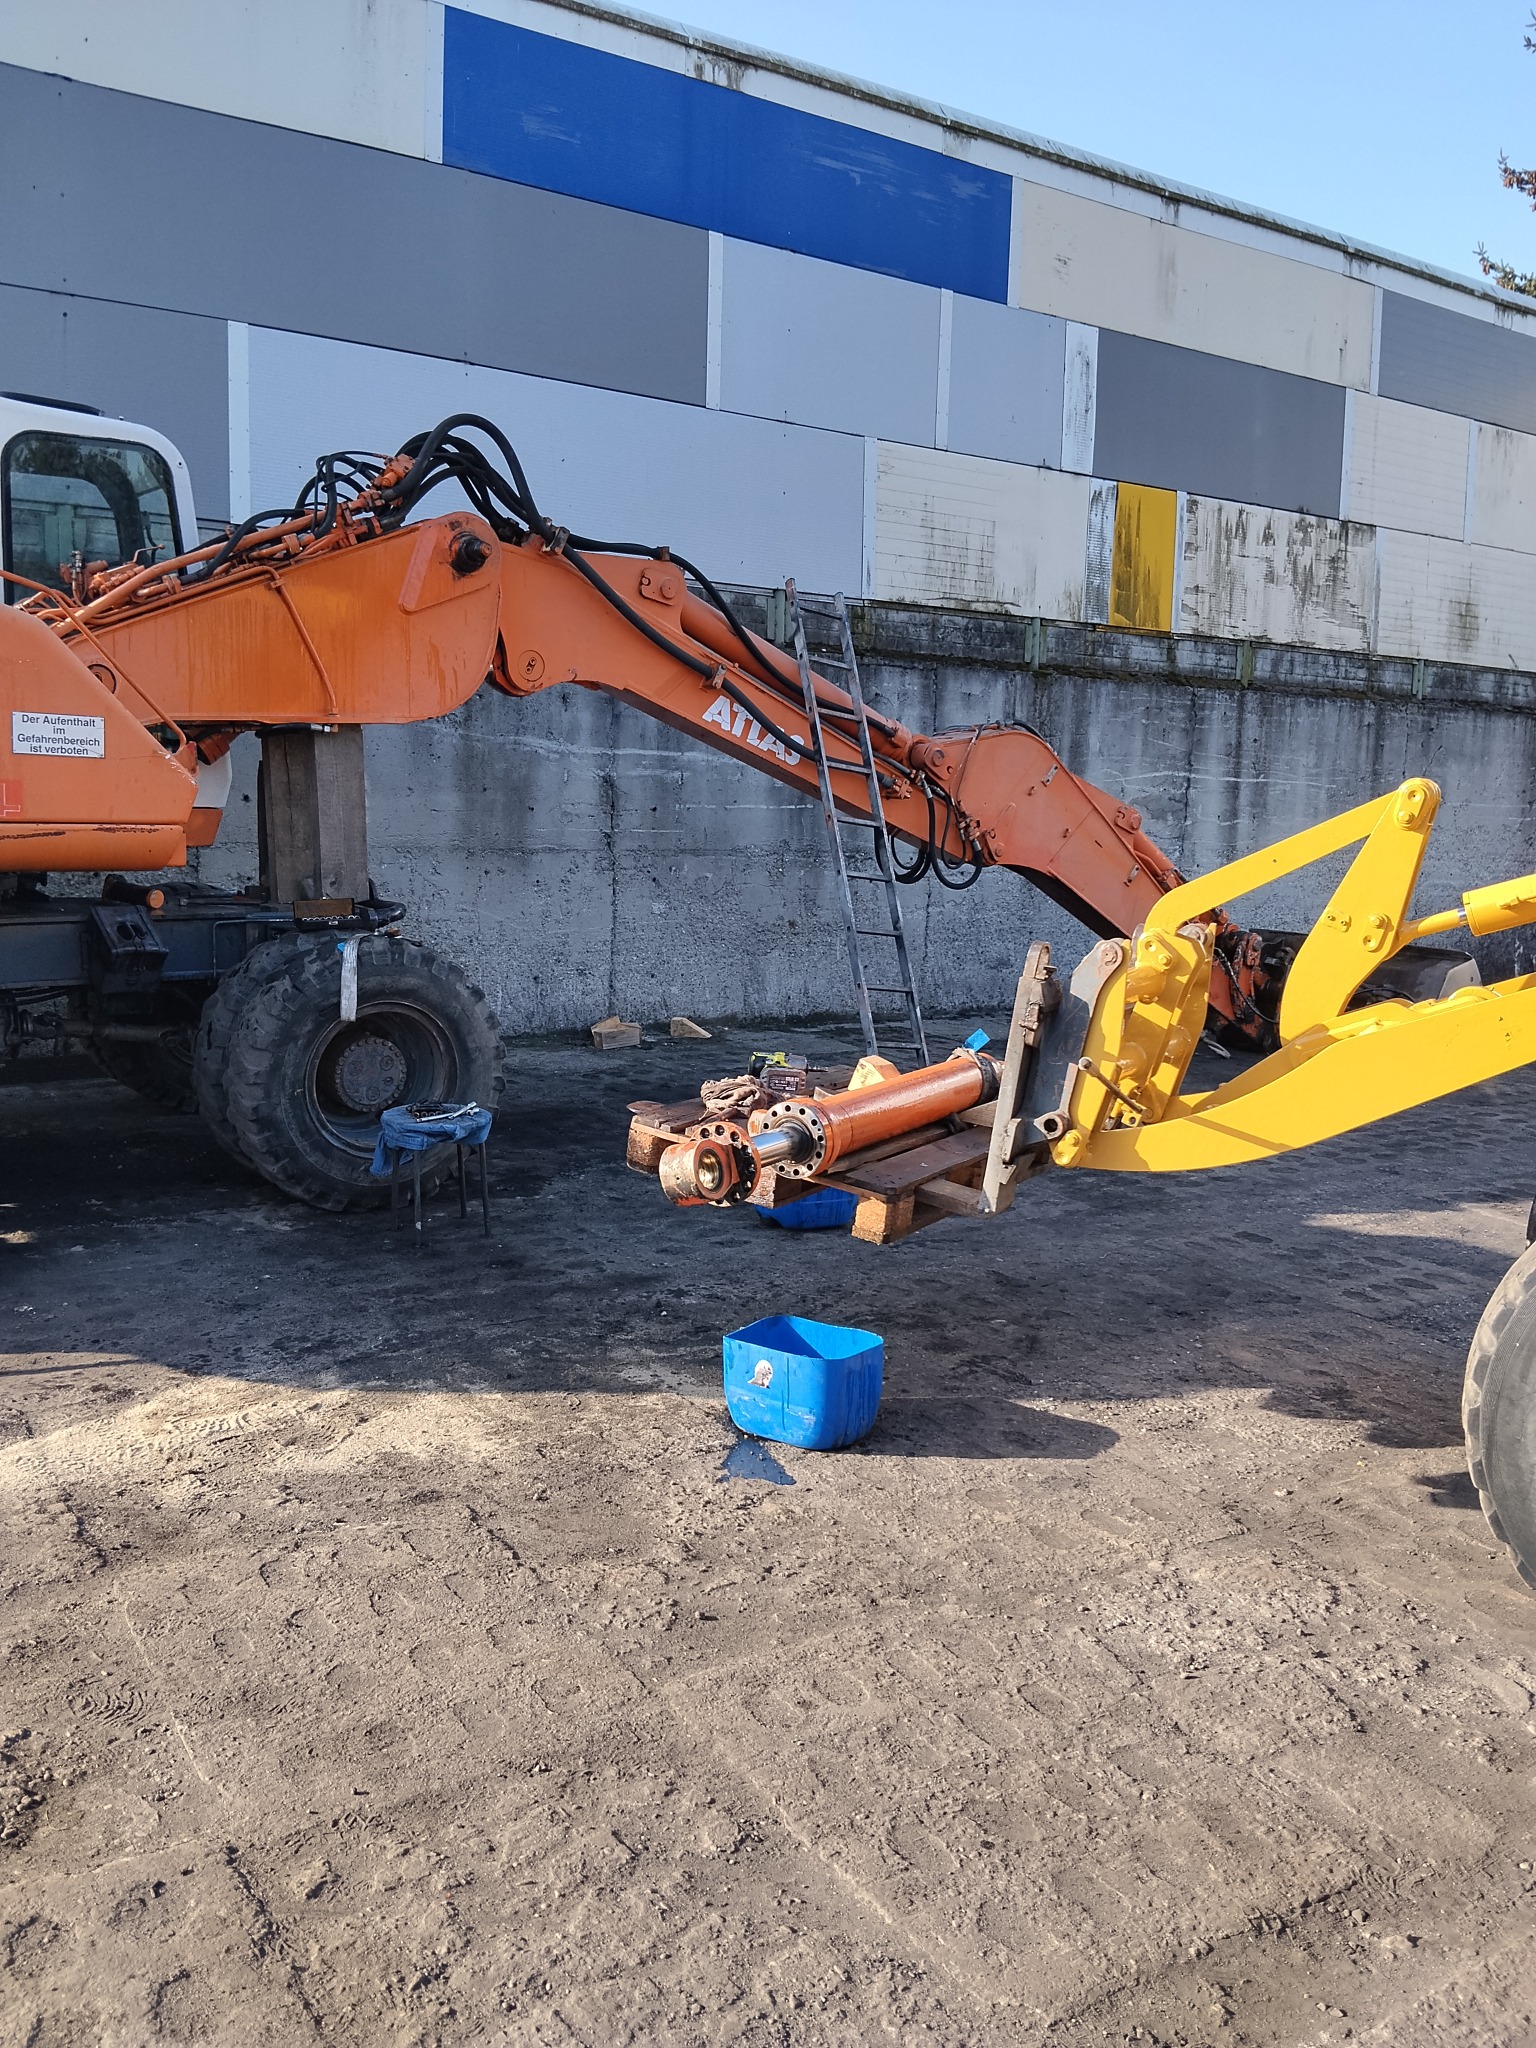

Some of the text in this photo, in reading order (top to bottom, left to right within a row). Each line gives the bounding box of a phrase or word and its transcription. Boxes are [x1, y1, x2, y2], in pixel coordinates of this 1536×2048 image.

[21, 714, 96, 728] Der Aufenthalt
[53, 726, 66, 735] im
[17, 733, 100, 747] Gefahrenbereich
[30, 744, 89, 756] ist verboten
